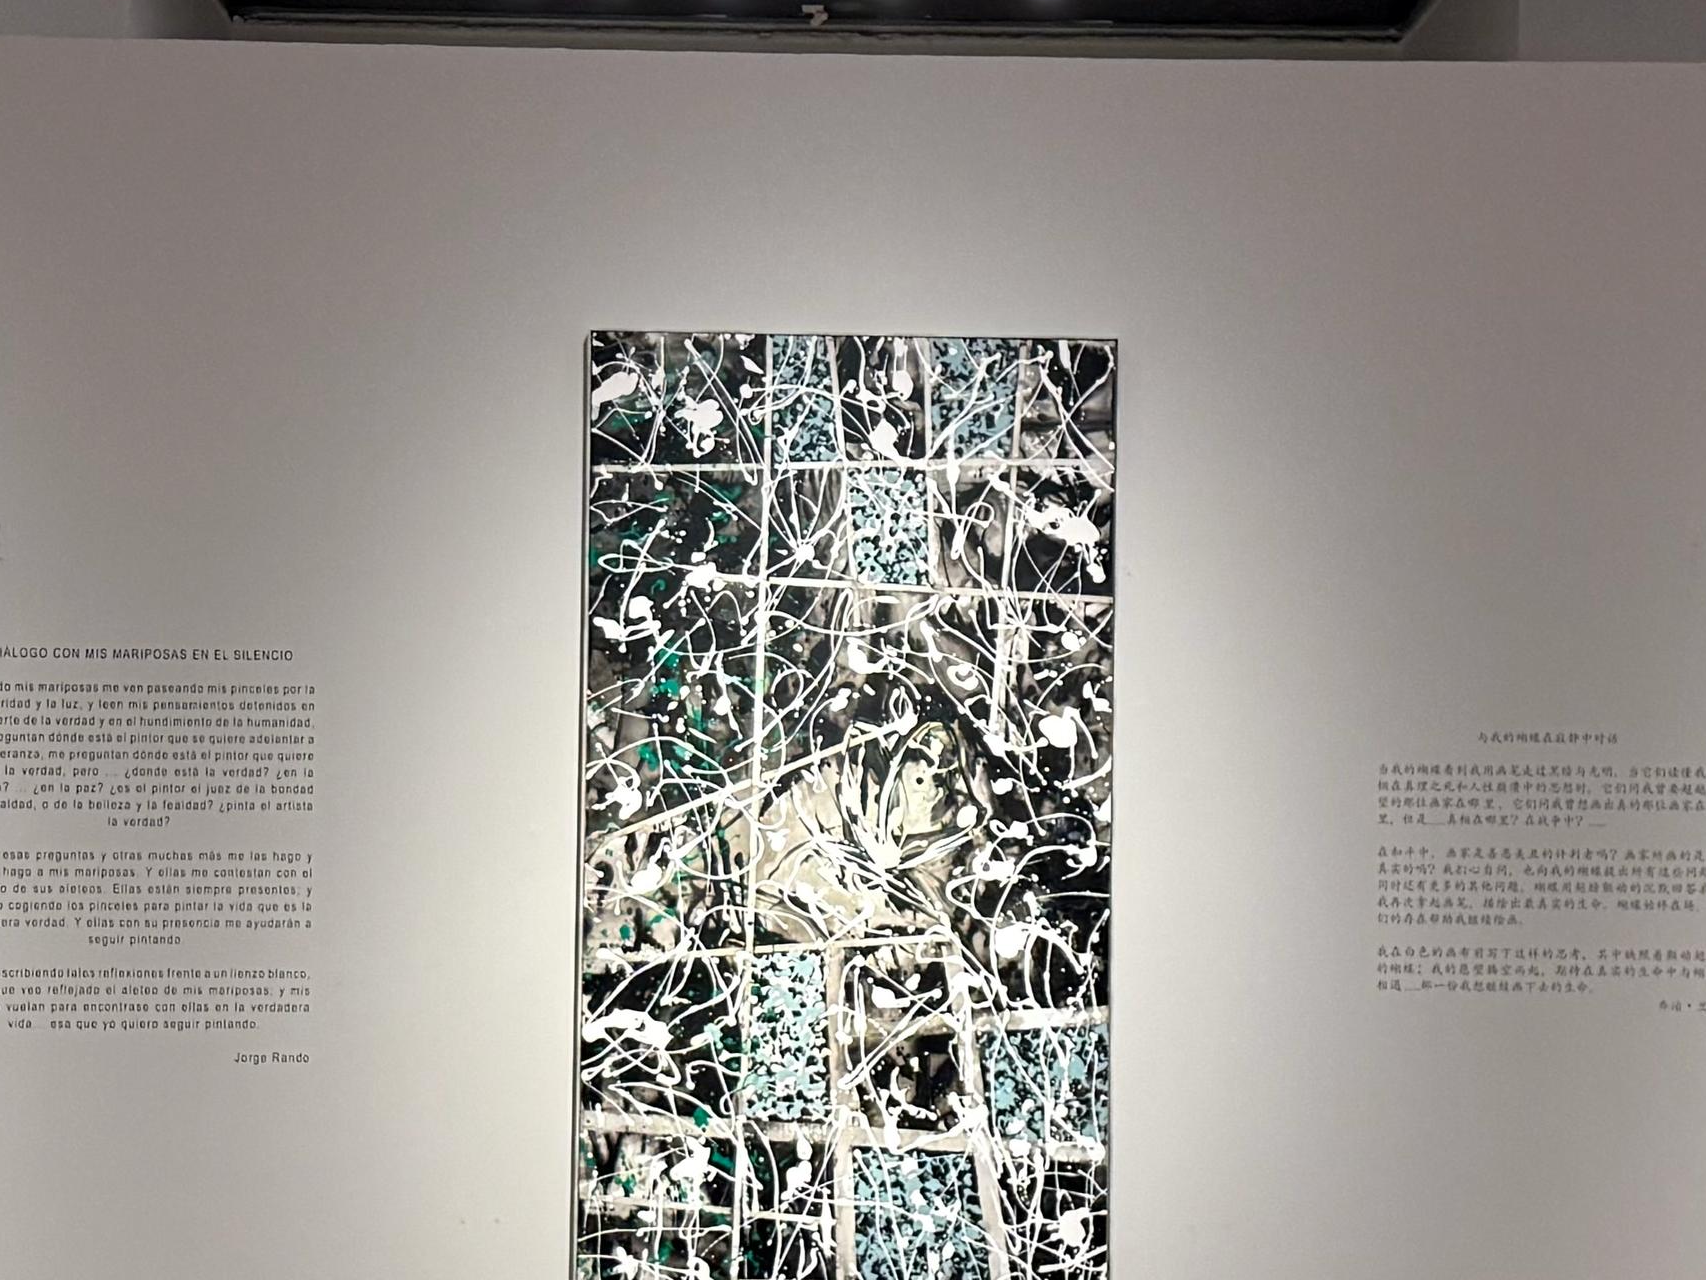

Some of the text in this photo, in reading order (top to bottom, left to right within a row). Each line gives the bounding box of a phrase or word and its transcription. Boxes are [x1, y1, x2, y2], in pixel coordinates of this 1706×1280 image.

[52, 647, 80, 659] CON
[84, 647, 107, 659] MIS
[112, 648, 187, 660] MARIPOSAS
[192, 648, 209, 660] EN
[213, 648, 231, 661] EL
[233, 648, 293, 661] SILENCIO
[14, 681, 34, 692] mis
[37, 681, 99, 695] mariposas
[122, 684, 144, 694] ven
[146, 682, 204, 696] paseando
[207, 682, 227, 694] mis
[230, 683, 279, 696] pinceles
[282, 685, 302, 697] por
[98, 698, 123, 710] leen
[128, 699, 148, 710] mis
[152, 700, 235, 713] pensamientos
[239, 700, 297, 711] detenidos
[55, 715, 95, 726] verdad
[139, 716, 213, 728] hundimiento
[87, 732, 113, 743] está
[129, 732, 164, 745] pintor
[167, 734, 189, 745] que
[208, 733, 245, 746] quiere
[248, 733, 305, 744] adelantar
[68, 749, 129, 762] preguntan
[171, 749, 197, 761] está
[214, 750, 249, 763] pintor
[252, 752, 274, 763] que
[277, 750, 314, 763] quiere
[72, 767, 99, 779] pero
[173, 766, 199, 778] está
[221, 766, 269, 778] verdad?
[275, 768, 297, 780] ¿en
[32, 783, 55, 795] ¿en
[75, 781, 104, 795] paz?
[109, 784, 131, 796] ¿es
[151, 783, 185, 796] pintor
[205, 783, 231, 796] juez
[270, 783, 314, 795] bondad
[88, 799, 131, 810] belleza
[162, 799, 214, 811] fealdad?
[218, 799, 255, 813] ¿pinta
[275, 800, 313, 811] artista
[123, 815, 171, 827] verdad?
[2, 850, 30, 860] esas
[35, 850, 95, 863] preguntas
[112, 850, 143, 861] otras
[147, 849, 193, 861] muchas
[198, 850, 222, 861] más
[249, 850, 267, 861] las
[272, 851, 301, 864] hago
[2, 866, 32, 879] hago
[48, 866, 69, 878] mis
[157, 866, 187, 878] ellas
[213, 867, 271, 878] contestan
[276, 868, 297, 879] con
[31, 884, 53, 894] sus
[112, 882, 142, 894] Ellas
[147, 883, 180, 895] están
[185, 883, 232, 897] siempre
[67, 900, 84, 911] los
[88, 900, 139, 914] pinceles
[143, 902, 169, 914] para
[174, 901, 209, 914] pintar
[228, 900, 253, 912] vida
[257, 903, 279, 914] que
[86, 916, 115, 928] ellas
[118, 919, 140, 928] con
[161, 918, 220, 931] presencia
[87, 934, 125, 947] seguir
[99, 967, 164, 979] reflexiones
[166, 967, 201, 979] frente
[229, 967, 265, 979] lienzo
[20, 985, 42, 995] veo
[47, 983, 101, 998] reflejado
[121, 983, 159, 996] aleteo
[182, 985, 203, 995] mis
[289, 985, 311, 996] mis
[50, 1003, 77, 1014] para
[154, 1003, 176, 1013] con
[181, 1001, 209, 1013] ellas
[250, 1002, 310, 1013] verdadera
[7, 1017, 32, 1029] vida
[49, 1019, 71, 1030] esa
[75, 1020, 98, 1031] que
[120, 1018, 159, 1031] quiero
[162, 1019, 200, 1032] seguir
[233, 1051, 310, 1065] Jorge Rando
